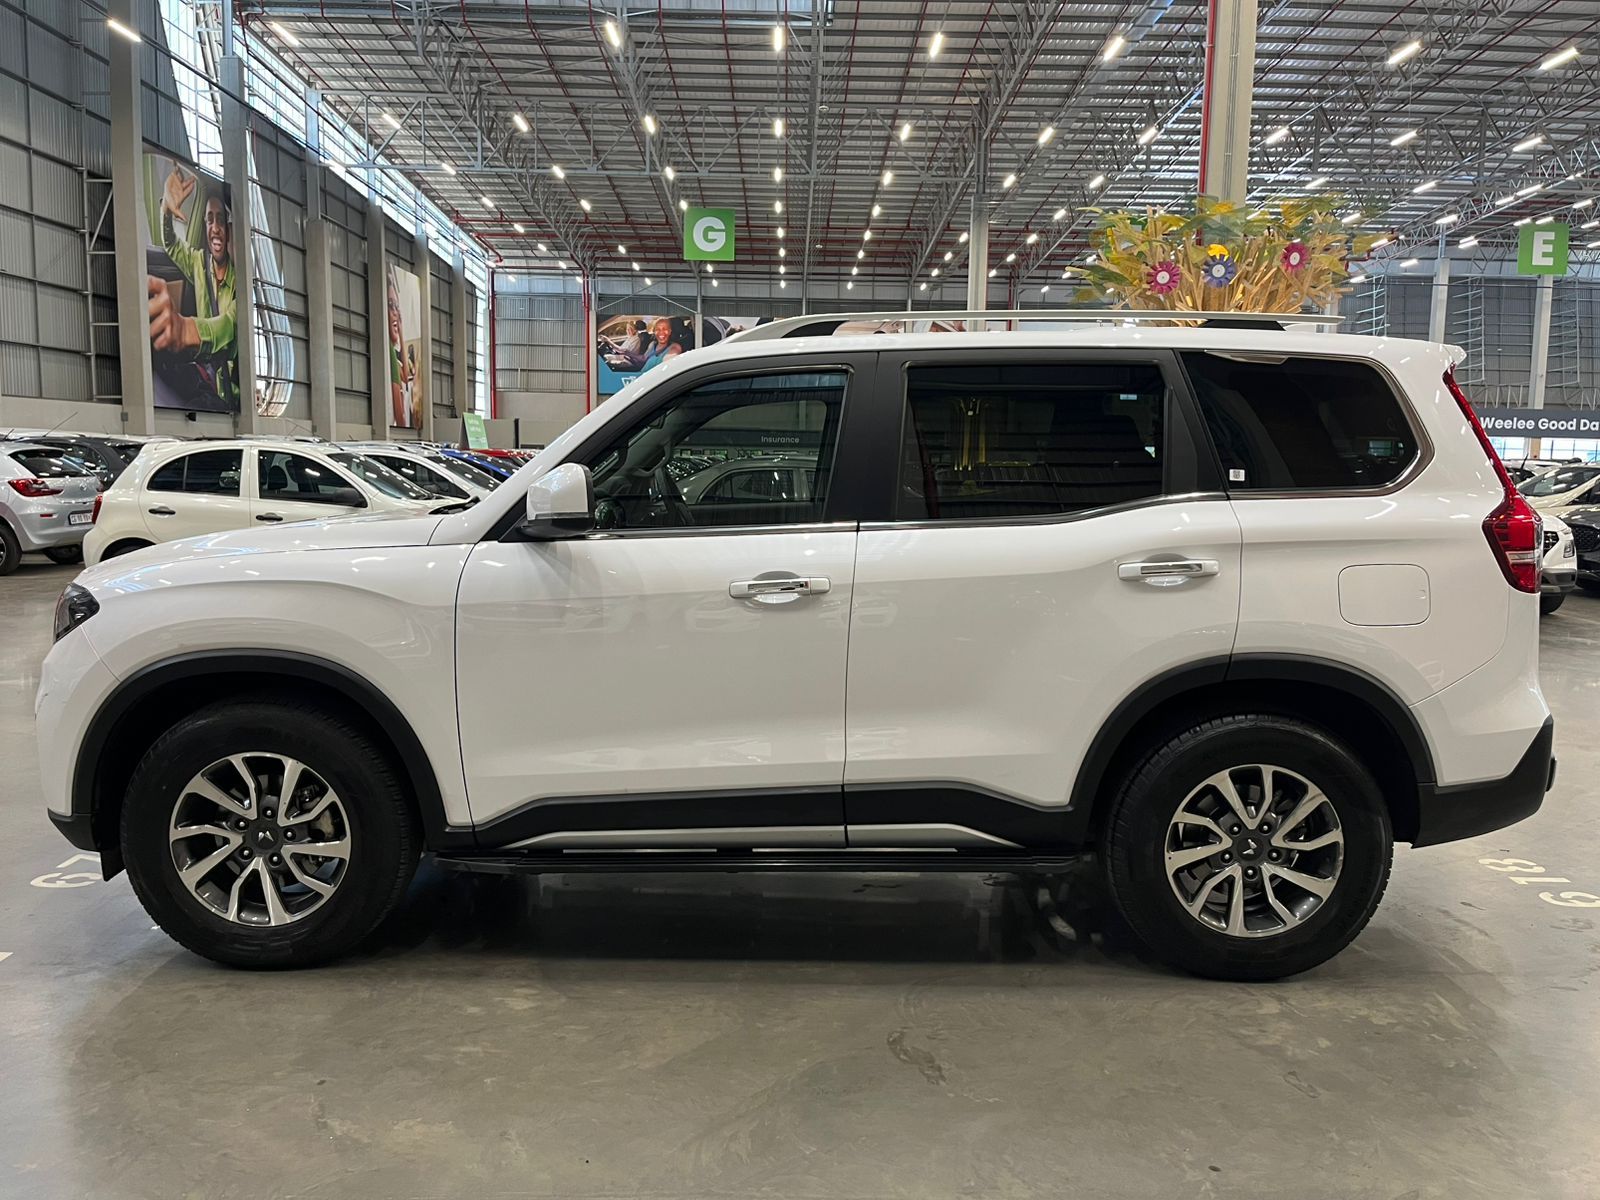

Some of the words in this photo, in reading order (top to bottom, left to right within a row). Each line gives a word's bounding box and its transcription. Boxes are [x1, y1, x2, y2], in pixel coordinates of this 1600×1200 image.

[693, 216, 726, 252] G
[1531, 231, 1555, 266] E
[1480, 417, 1535, 430] Weelee
[1538, 418, 1577, 431] Good
[1580, 419, 1600, 431] Da
[761, 436, 800, 444] Insurance
